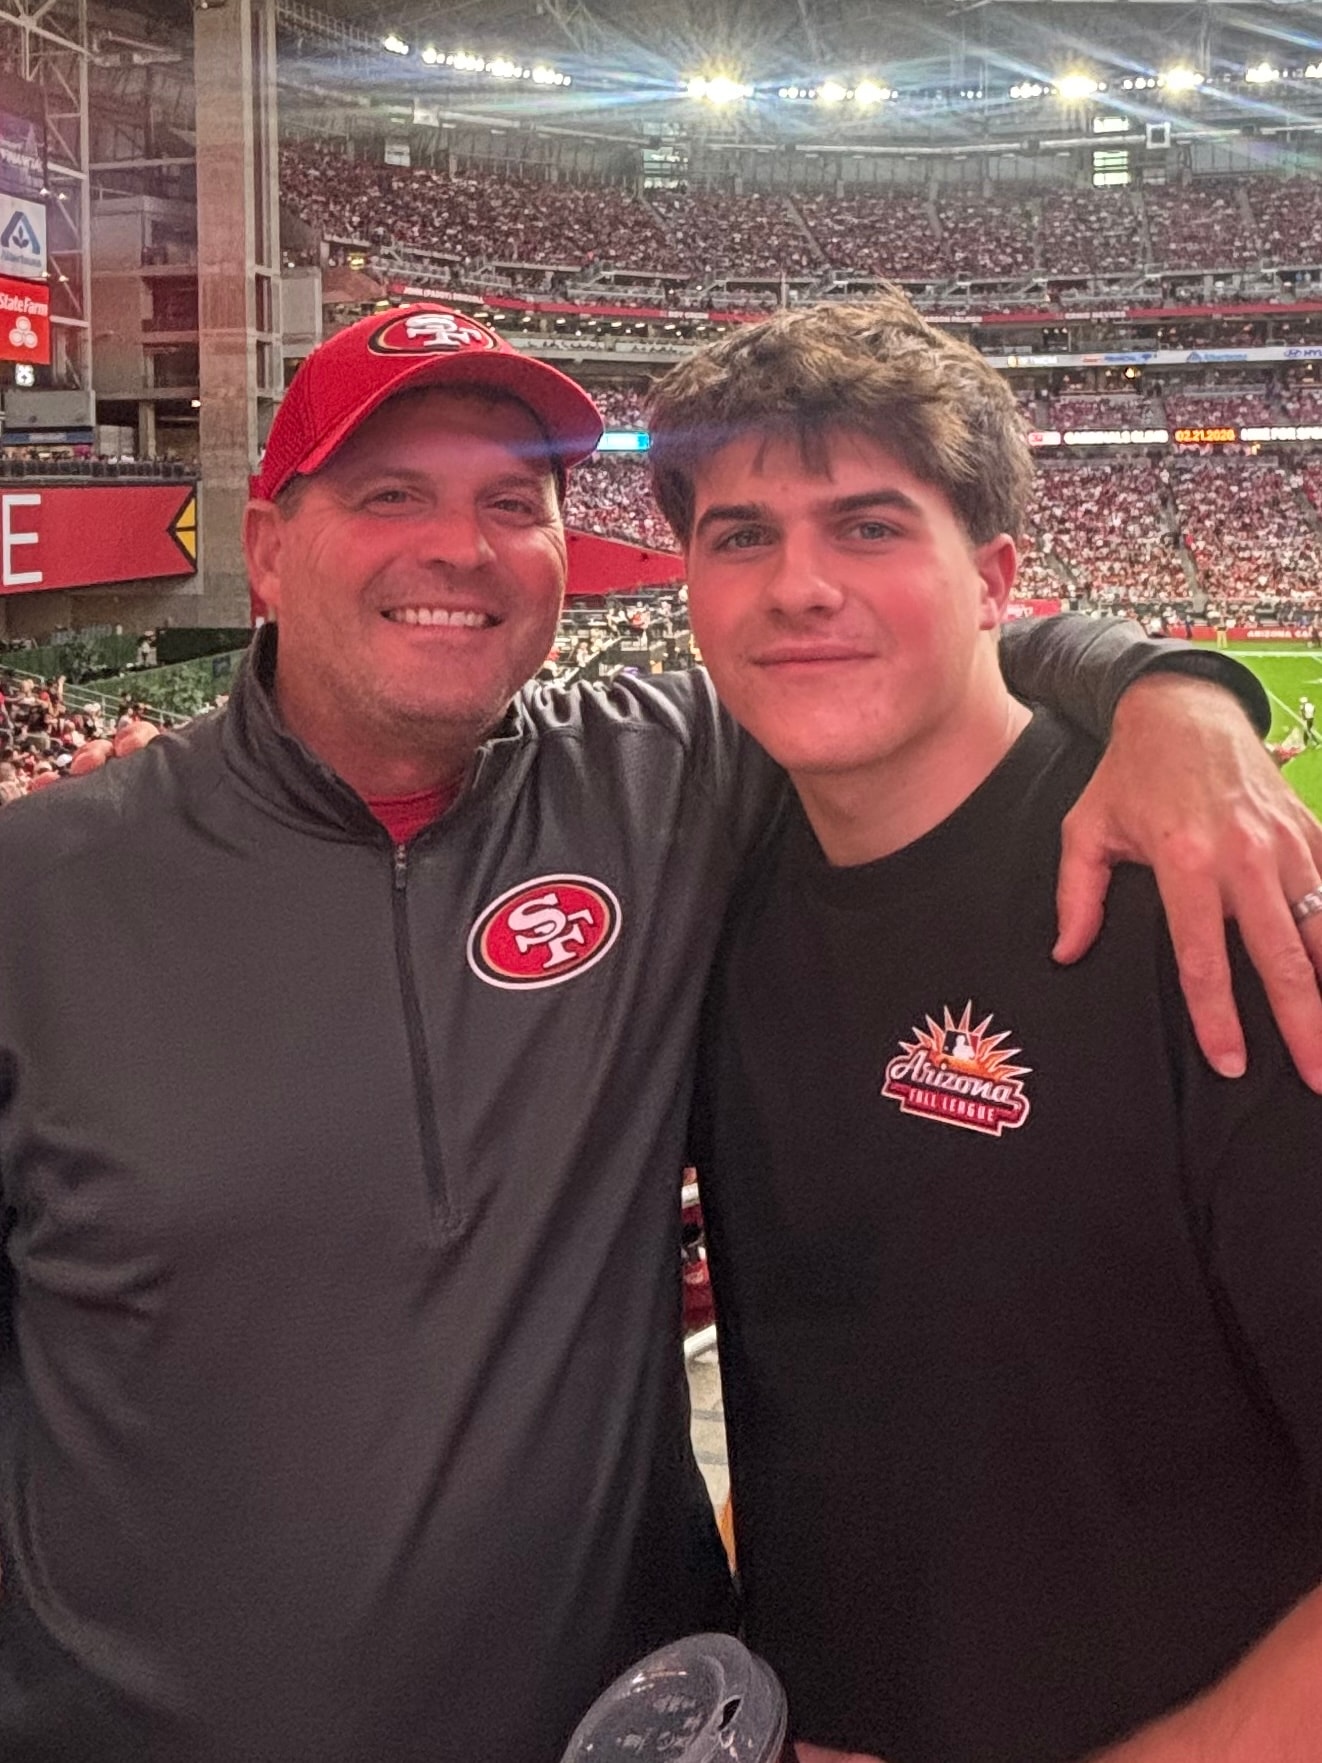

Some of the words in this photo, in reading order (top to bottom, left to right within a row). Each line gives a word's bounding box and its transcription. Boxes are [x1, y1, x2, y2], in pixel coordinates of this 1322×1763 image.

[890, 1049, 1021, 1110] Arizona
[909, 1088, 936, 1109] FALL
[942, 1098, 995, 1122] LEAGUE
